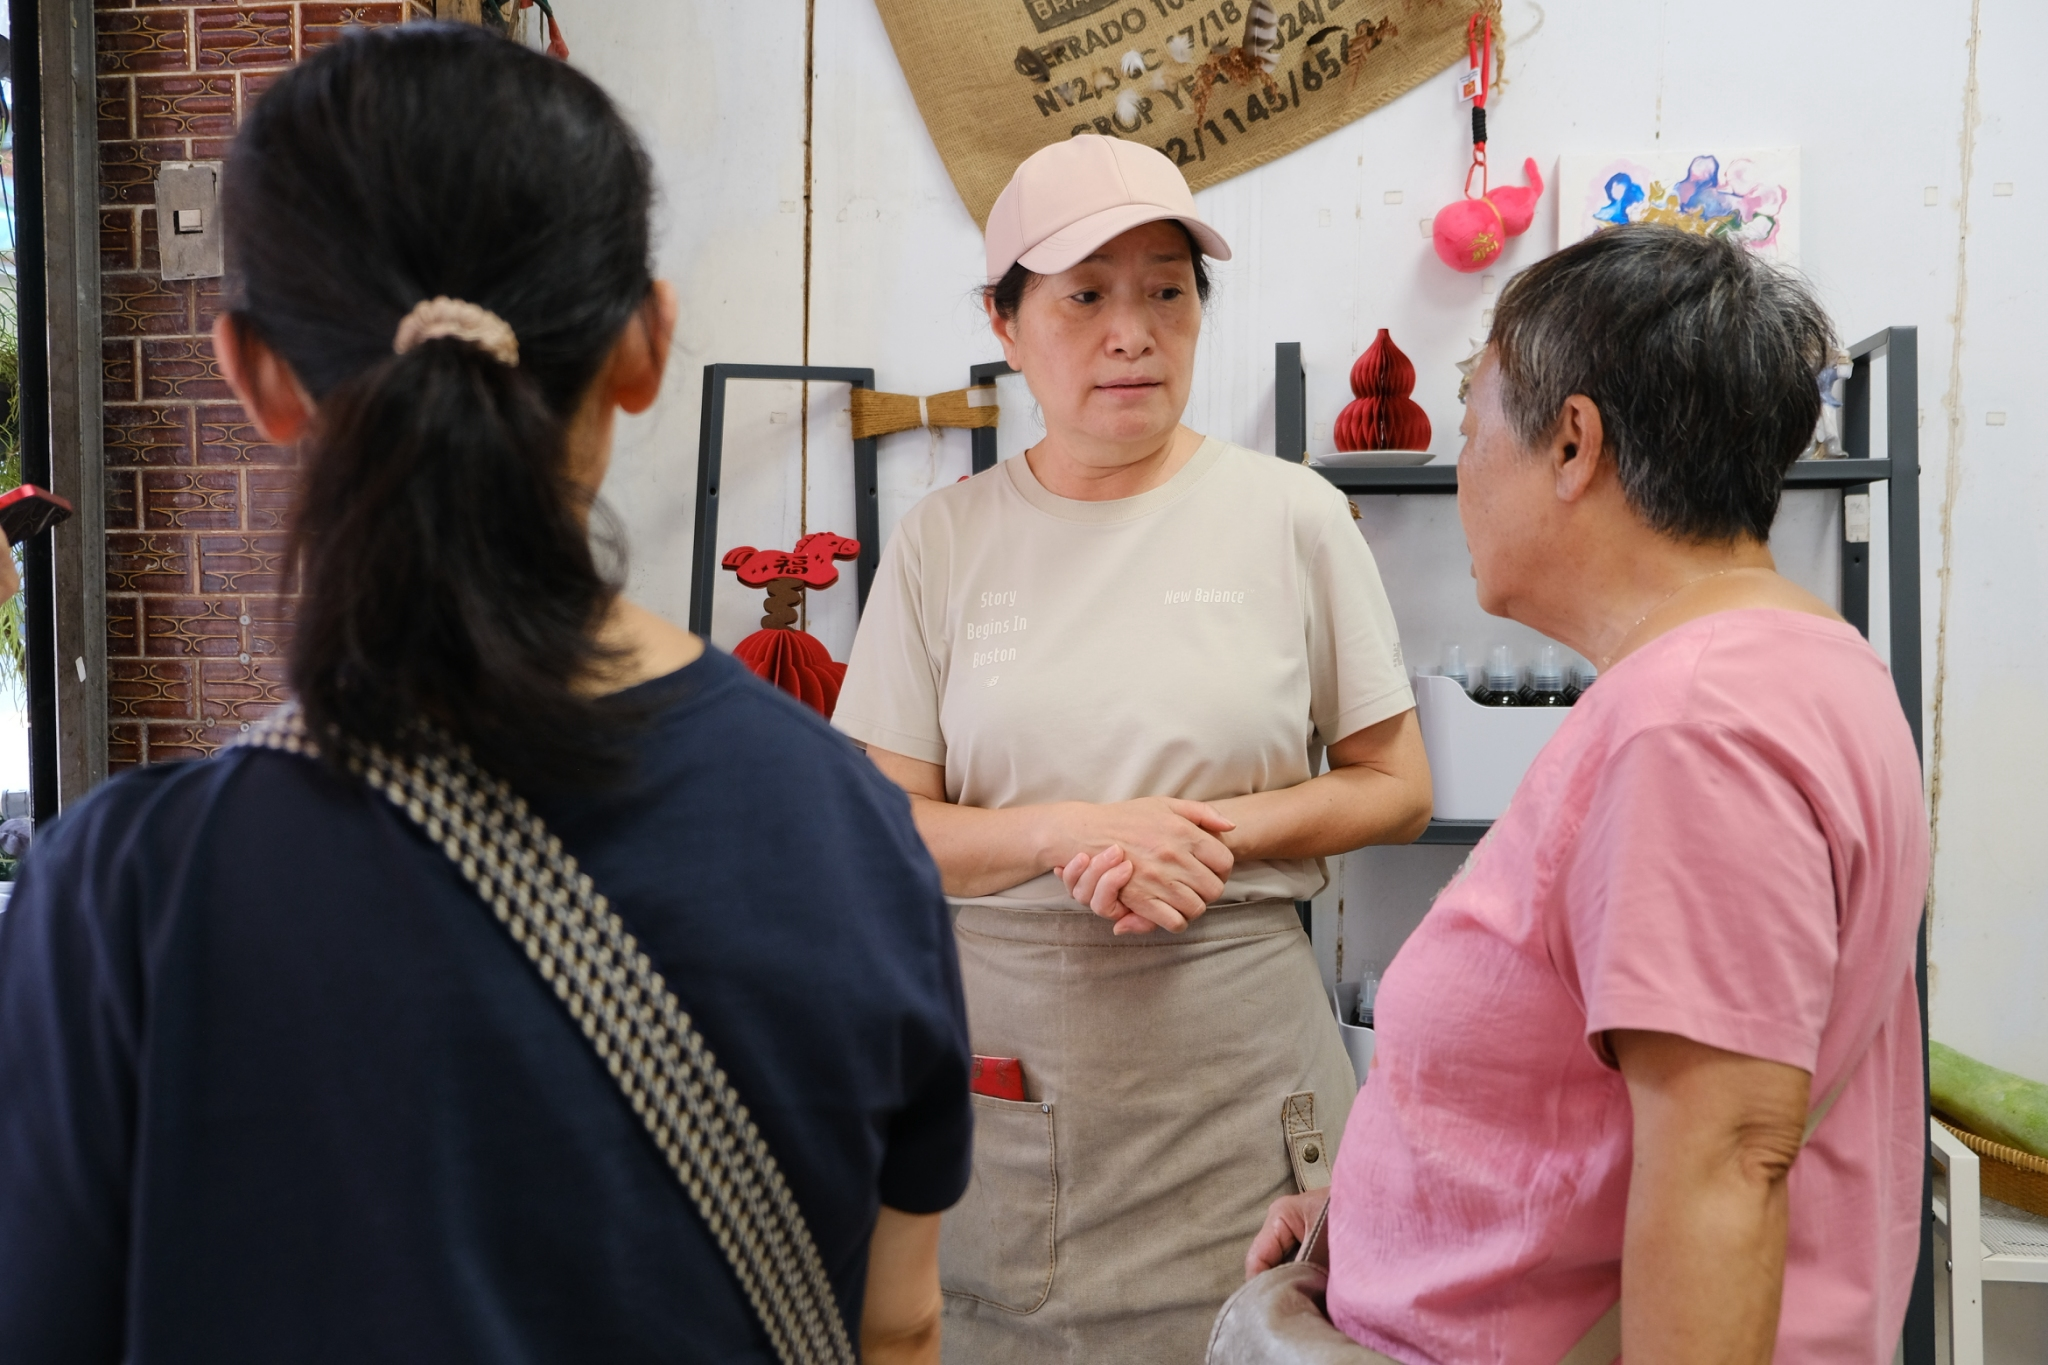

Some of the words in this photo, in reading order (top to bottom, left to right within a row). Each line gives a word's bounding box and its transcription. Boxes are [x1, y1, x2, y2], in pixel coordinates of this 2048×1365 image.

[1166, 0, 1242, 49] 7/18
[773, 555, 809, 575] 福
[980, 590, 1017, 608] Story
[1163, 589, 1192, 605] New
[1194, 587, 1245, 604] Balance
[967, 618, 1010, 640] Begins
[1012, 615, 1027, 632] In
[972, 647, 1017, 669] Boston
